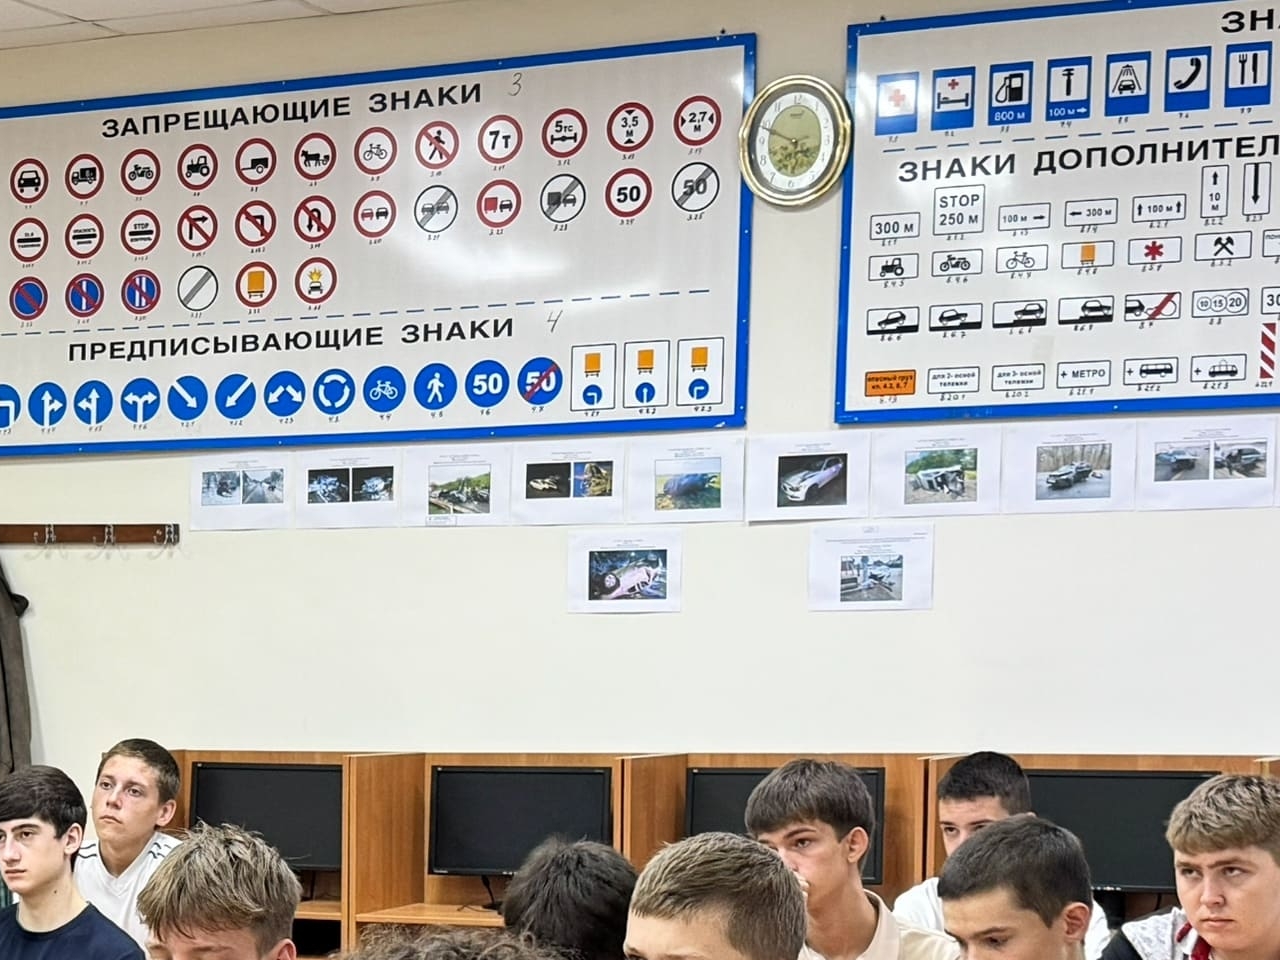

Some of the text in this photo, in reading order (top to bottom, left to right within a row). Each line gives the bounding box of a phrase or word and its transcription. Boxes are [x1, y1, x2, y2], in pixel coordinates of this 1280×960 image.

[1221, 8, 1280, 33] ЗН
[508, 72, 523, 97] 3
[102, 83, 481, 138] ЗАПРЕЩАЮЩИЕ ЗНАКИ
[994, 111, 1015, 121] 800
[899, 134, 1279, 182] ЗНАКИ ДОПОЛНИТЕЛ
[617, 185, 641, 203] 50
[1209, 192, 1221, 202] 10
[939, 194, 980, 208] STOP
[1086, 208, 1103, 217] 300
[1148, 204, 1163, 213] 100
[939, 213, 964, 226] 250
[1003, 215, 1019, 223] 100
[875, 222, 900, 235] 300
[1213, 299, 1223, 308] 15
[1229, 296, 1242, 307] 20
[69, 318, 513, 362] ПРЕДПИСЫВАЮЩИЕ ЗНАКИ
[1072, 369, 1106, 379] МЕТРО
[473, 372, 503, 395] 50
[525, 371, 556, 393] 50
